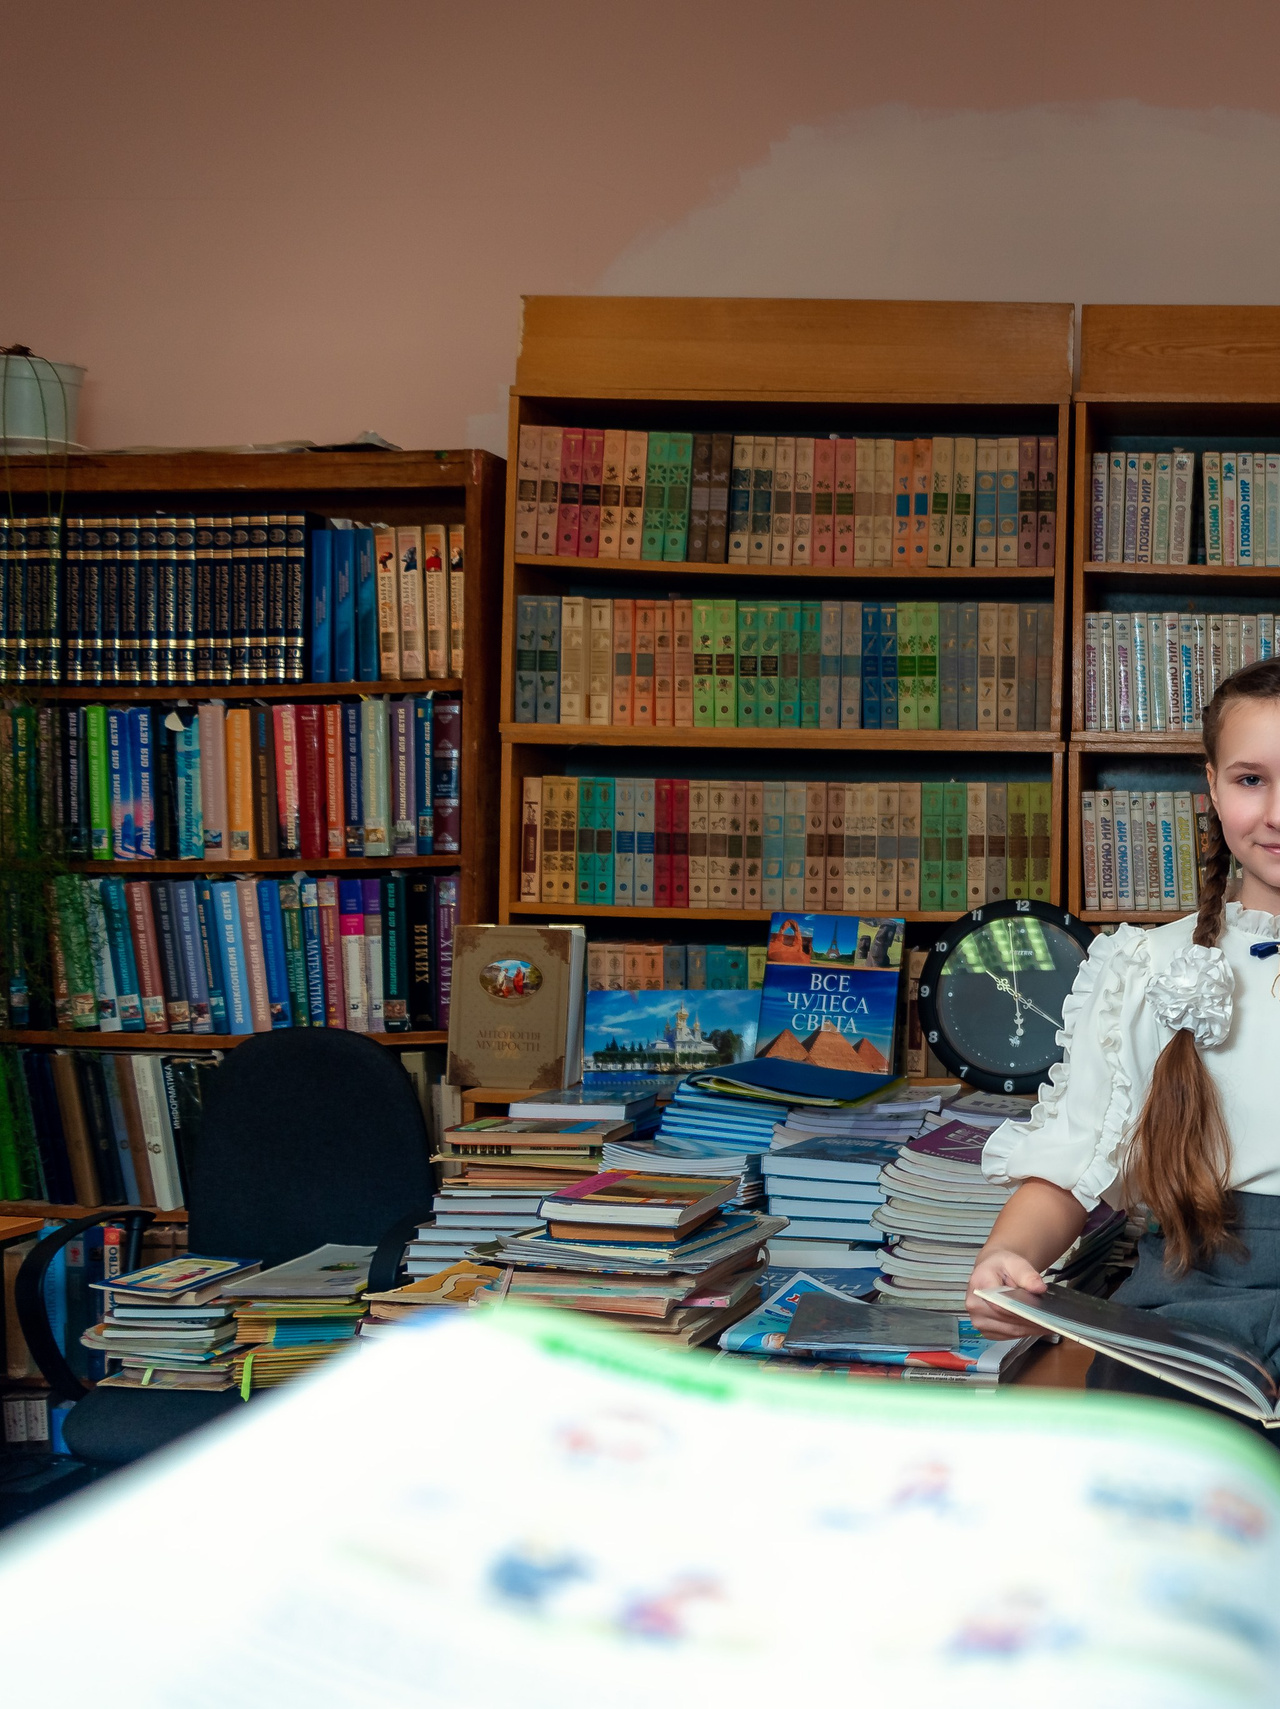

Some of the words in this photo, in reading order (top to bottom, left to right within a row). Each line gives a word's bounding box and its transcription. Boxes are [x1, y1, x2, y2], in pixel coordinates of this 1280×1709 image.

[1142, 479, 1151, 503] МИР
[1208, 476, 1220, 501] МИР
[1241, 480, 1250, 501] МИР
[1139, 506, 1150, 551] ПОЗНАЮ
[1209, 504, 1220, 550] ПОЗНАЮ
[1241, 504, 1250, 547] ПОЗНАЮ
[1138, 554, 1148, 562] Я
[1209, 552, 1220, 561] Я
[1241, 549, 1250, 557] Я
[69, 650, 73, 658] 8
[87, 650, 92, 658] 9
[124, 650, 132, 659] 11
[180, 650, 190, 659] 14
[200, 650, 209, 658] 15
[216, 650, 227, 658] 16
[235, 649, 245, 658] 17
[252, 649, 262, 658] 18
[270, 648, 280, 657] 19
[288, 649, 300, 657] 20
[1101, 817, 1111, 840] МИР
[1117, 821, 1127, 842] МИР
[1147, 821, 1156, 843] МИР
[1161, 821, 1171, 842] МИР
[1102, 843, 1112, 888] ПОЗНАЮ
[1118, 845, 1128, 887] ПОЗНАЮ
[1148, 846, 1158, 888] ПОЗНАЮ
[1163, 845, 1174, 887] ПОЗНАЮ
[1102, 891, 1113, 899] Я
[1119, 890, 1129, 898] Я
[1164, 890, 1175, 898] Я
[1016, 901, 1029, 911] 12
[972, 911, 982, 921] 11
[1064, 914, 1070, 925] 1
[935, 942, 947, 952] 10
[414, 924, 429, 983] ХИМИЯ
[307, 939, 322, 1015] МАТЕМАТИКА
[440, 939, 452, 1004] ХИМИЯ
[809, 973, 850, 992] ВСЕ
[921, 986, 929, 997] 9
[787, 992, 869, 1014] ЧУДЕСА
[792, 1013, 857, 1033] СВЕТА
[928, 1032, 937, 1043] 8
[960, 1067, 968, 1078] 7
[1004, 1081, 1013, 1092] 6
[164, 1064, 180, 1129] ИНФОРМАТИКА
